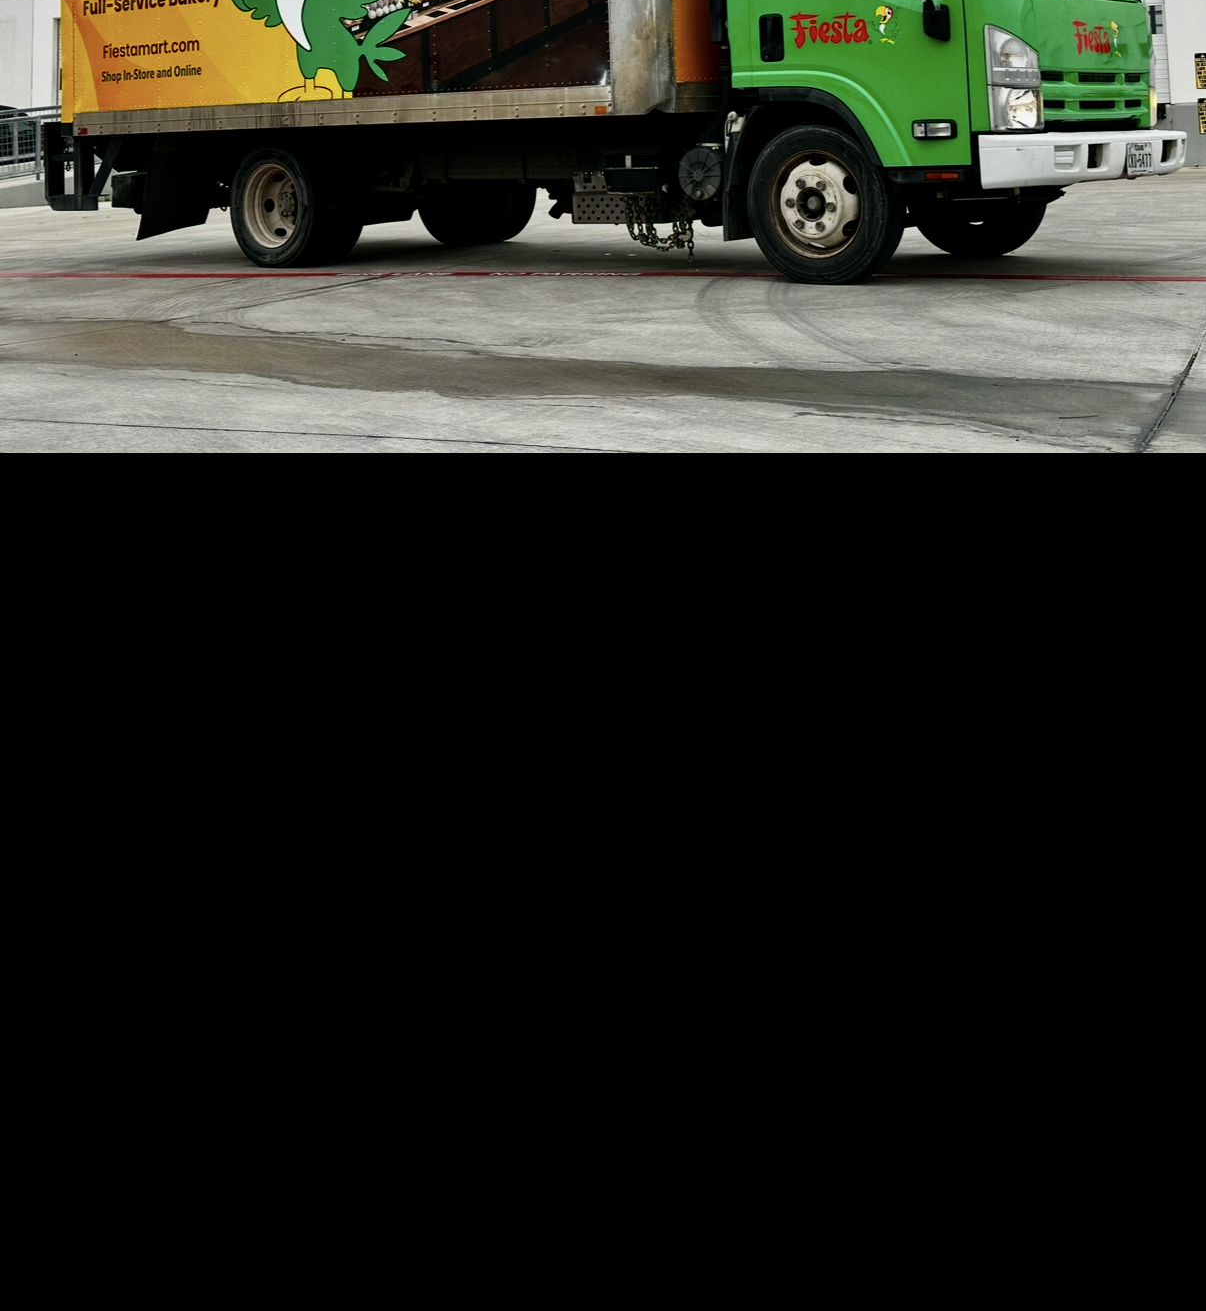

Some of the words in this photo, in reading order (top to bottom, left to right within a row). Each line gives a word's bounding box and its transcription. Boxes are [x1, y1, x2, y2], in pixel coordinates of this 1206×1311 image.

[789, 11, 870, 49] Fiesta
[1071, 18, 1112, 56] Fiesta
[102, 39, 200, 59] Fiestamart.com
[101, 70, 122, 84] Shop
[123, 68, 155, 81] In-Store
[156, 66, 172, 78] and
[174, 64, 202, 78] Online
